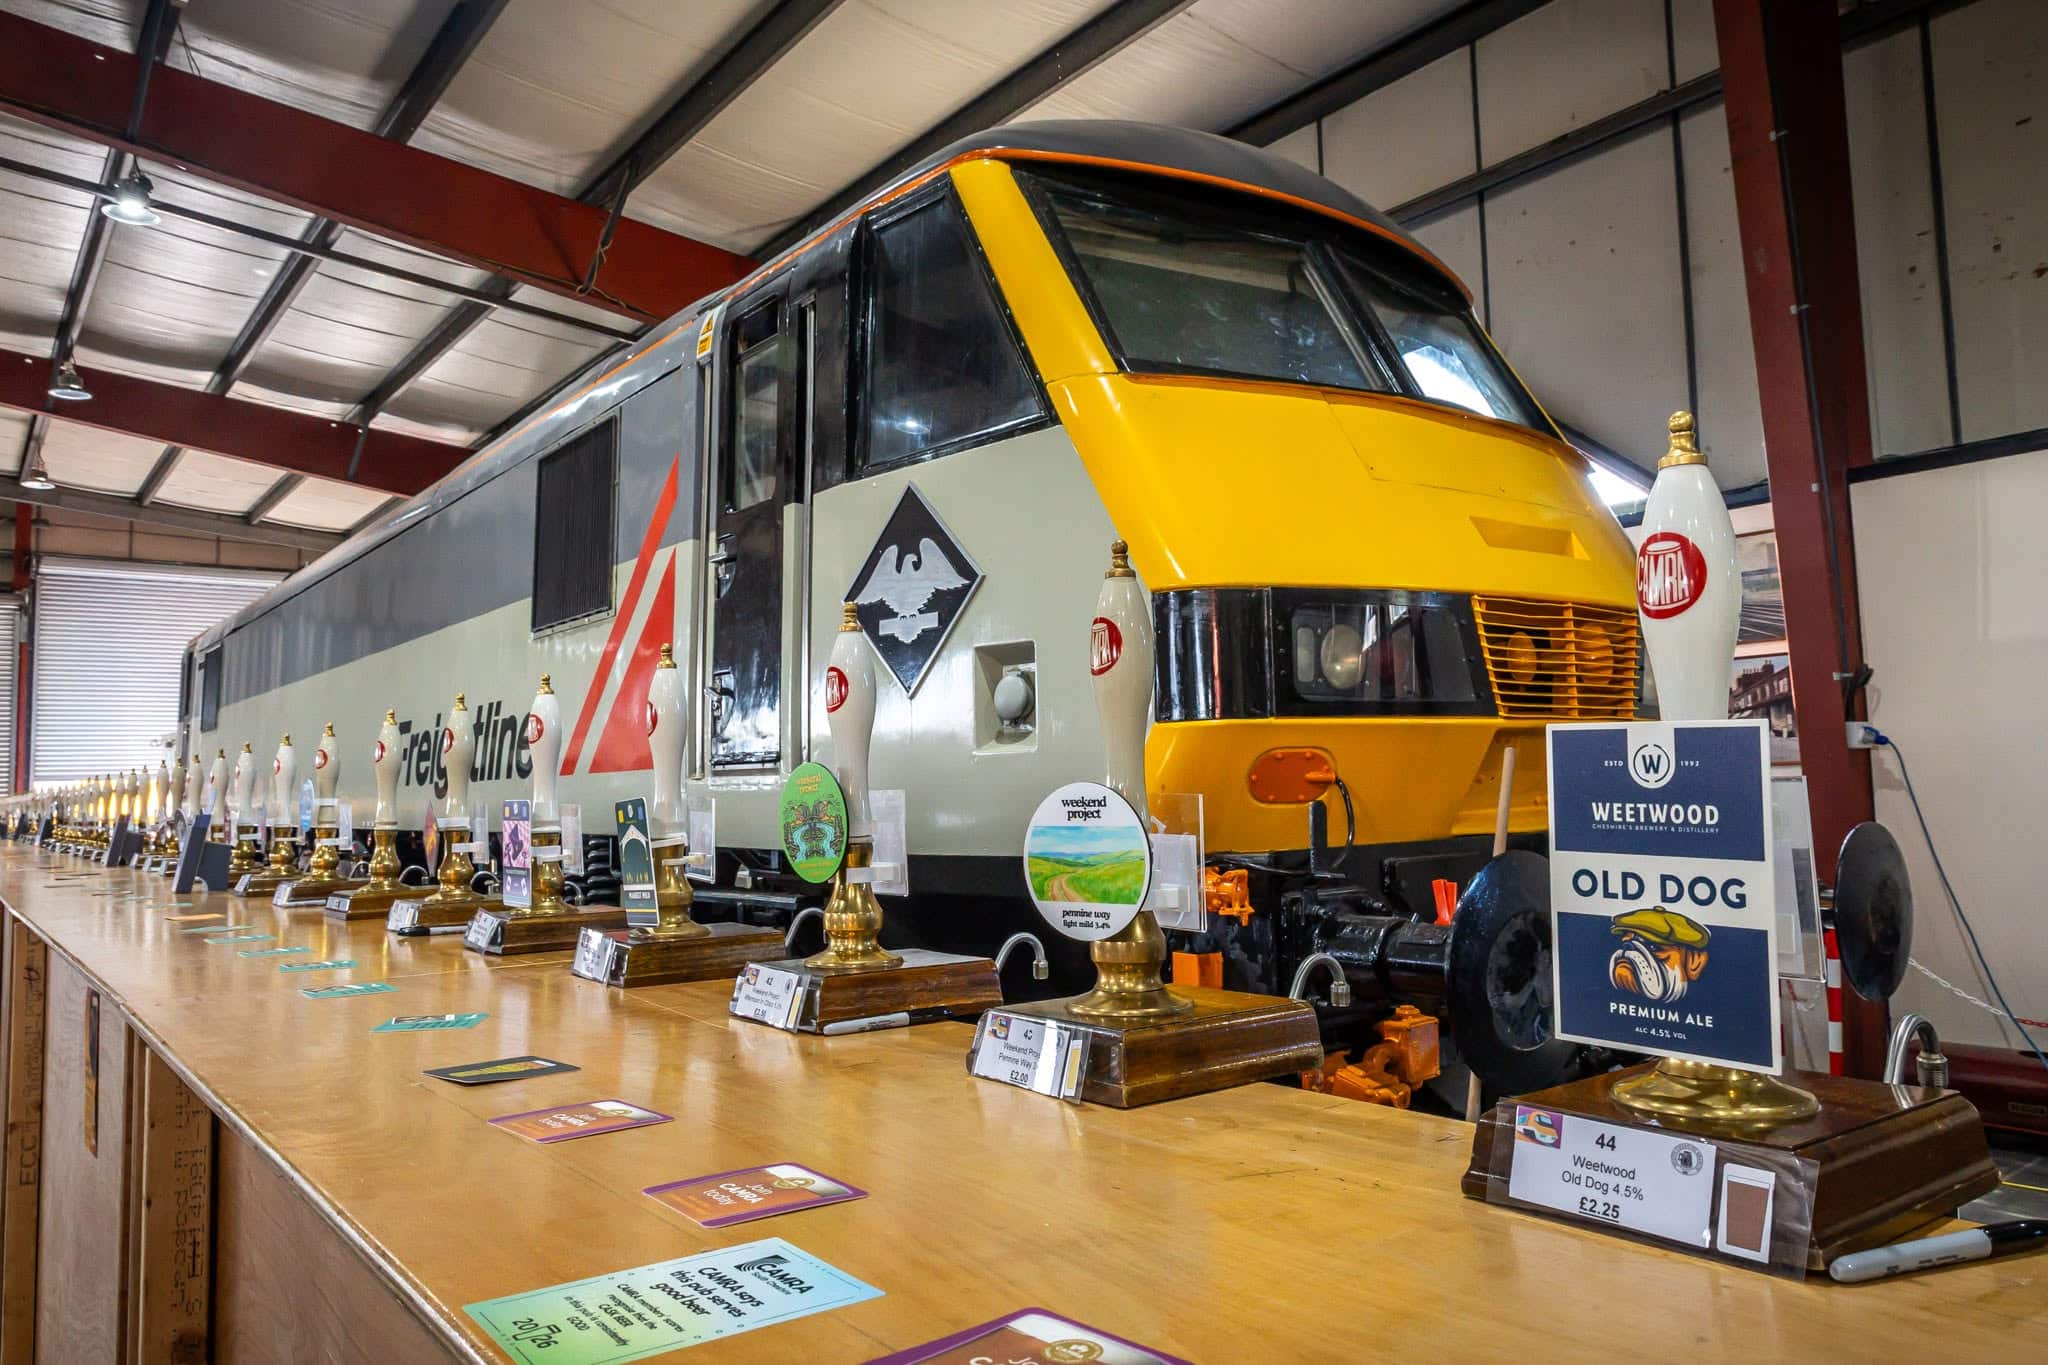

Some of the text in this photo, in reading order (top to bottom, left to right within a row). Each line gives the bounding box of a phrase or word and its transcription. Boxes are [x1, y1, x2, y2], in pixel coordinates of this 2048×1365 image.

[1638, 550, 1690, 605] CAMRA
[398, 700, 533, 799] Freigtline
[1641, 754, 1662, 774] W
[1061, 796, 1107, 809] weekend
[1067, 808, 1102, 822] project
[1591, 802, 1720, 825] WEETWOOD
[1678, 826, 1720, 834] DISTILLERY
[1572, 868, 1747, 909] OLD DOG
[1062, 908, 1111, 921] pennine way
[1063, 919, 1077, 929] light
[1079, 920, 1093, 928] mild
[1609, 1002, 1713, 1028] PREMIUM ALE
[1635, 1026, 1687, 1040] ALC 4.5% VOL
[1595, 1133, 1616, 1151] 44
[1572, 1154, 1636, 1181] Weetwood
[1562, 1170, 1644, 1201] Old Dog 4.5%
[1578, 1196, 1621, 1219] £2.25
[698, 1266, 765, 1308] CAMRA says
[756, 1262, 815, 1295] CAMRA
[617, 1283, 642, 1300] CAMRA
[649, 1281, 712, 1316] good beer
[670, 1270, 747, 1318] this pub serves
[598, 1303, 635, 1328] CASK BEER
[512, 1317, 559, 1350] 20 26
